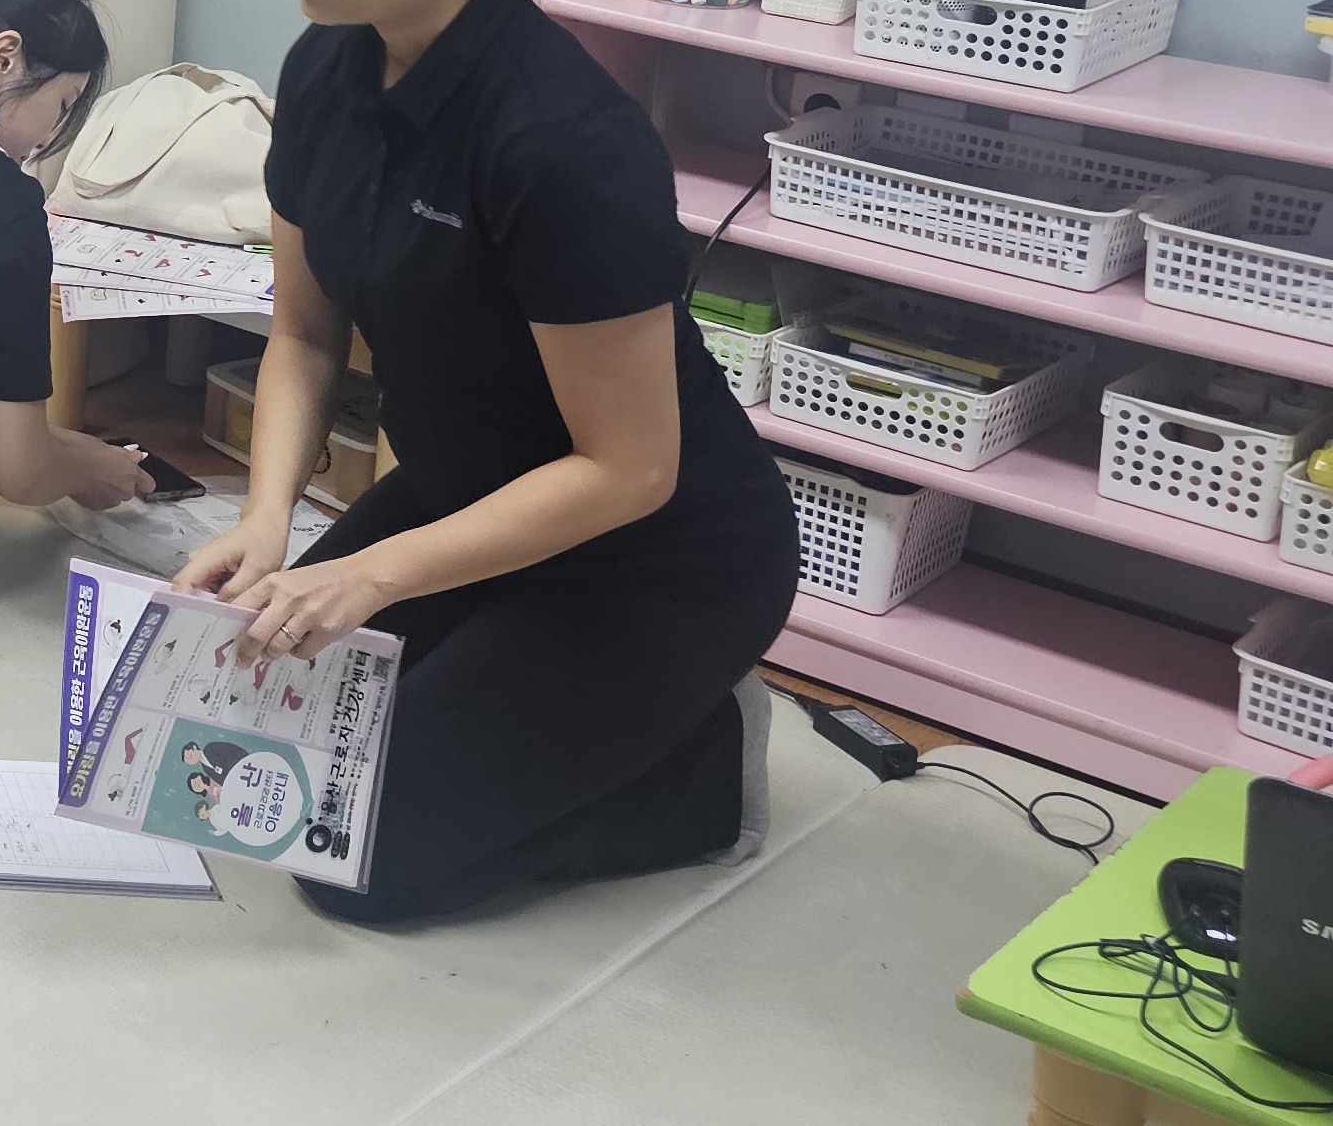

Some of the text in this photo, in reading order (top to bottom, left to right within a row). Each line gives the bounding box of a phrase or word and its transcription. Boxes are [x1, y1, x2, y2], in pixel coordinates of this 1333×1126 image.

[72, 584, 95, 677] 근육이완운동
[69, 677, 86, 726] 이용한
[70, 611, 162, 800] 요가링을 이용한 근육이완운동
[264, 771, 290, 833] 이용안내
